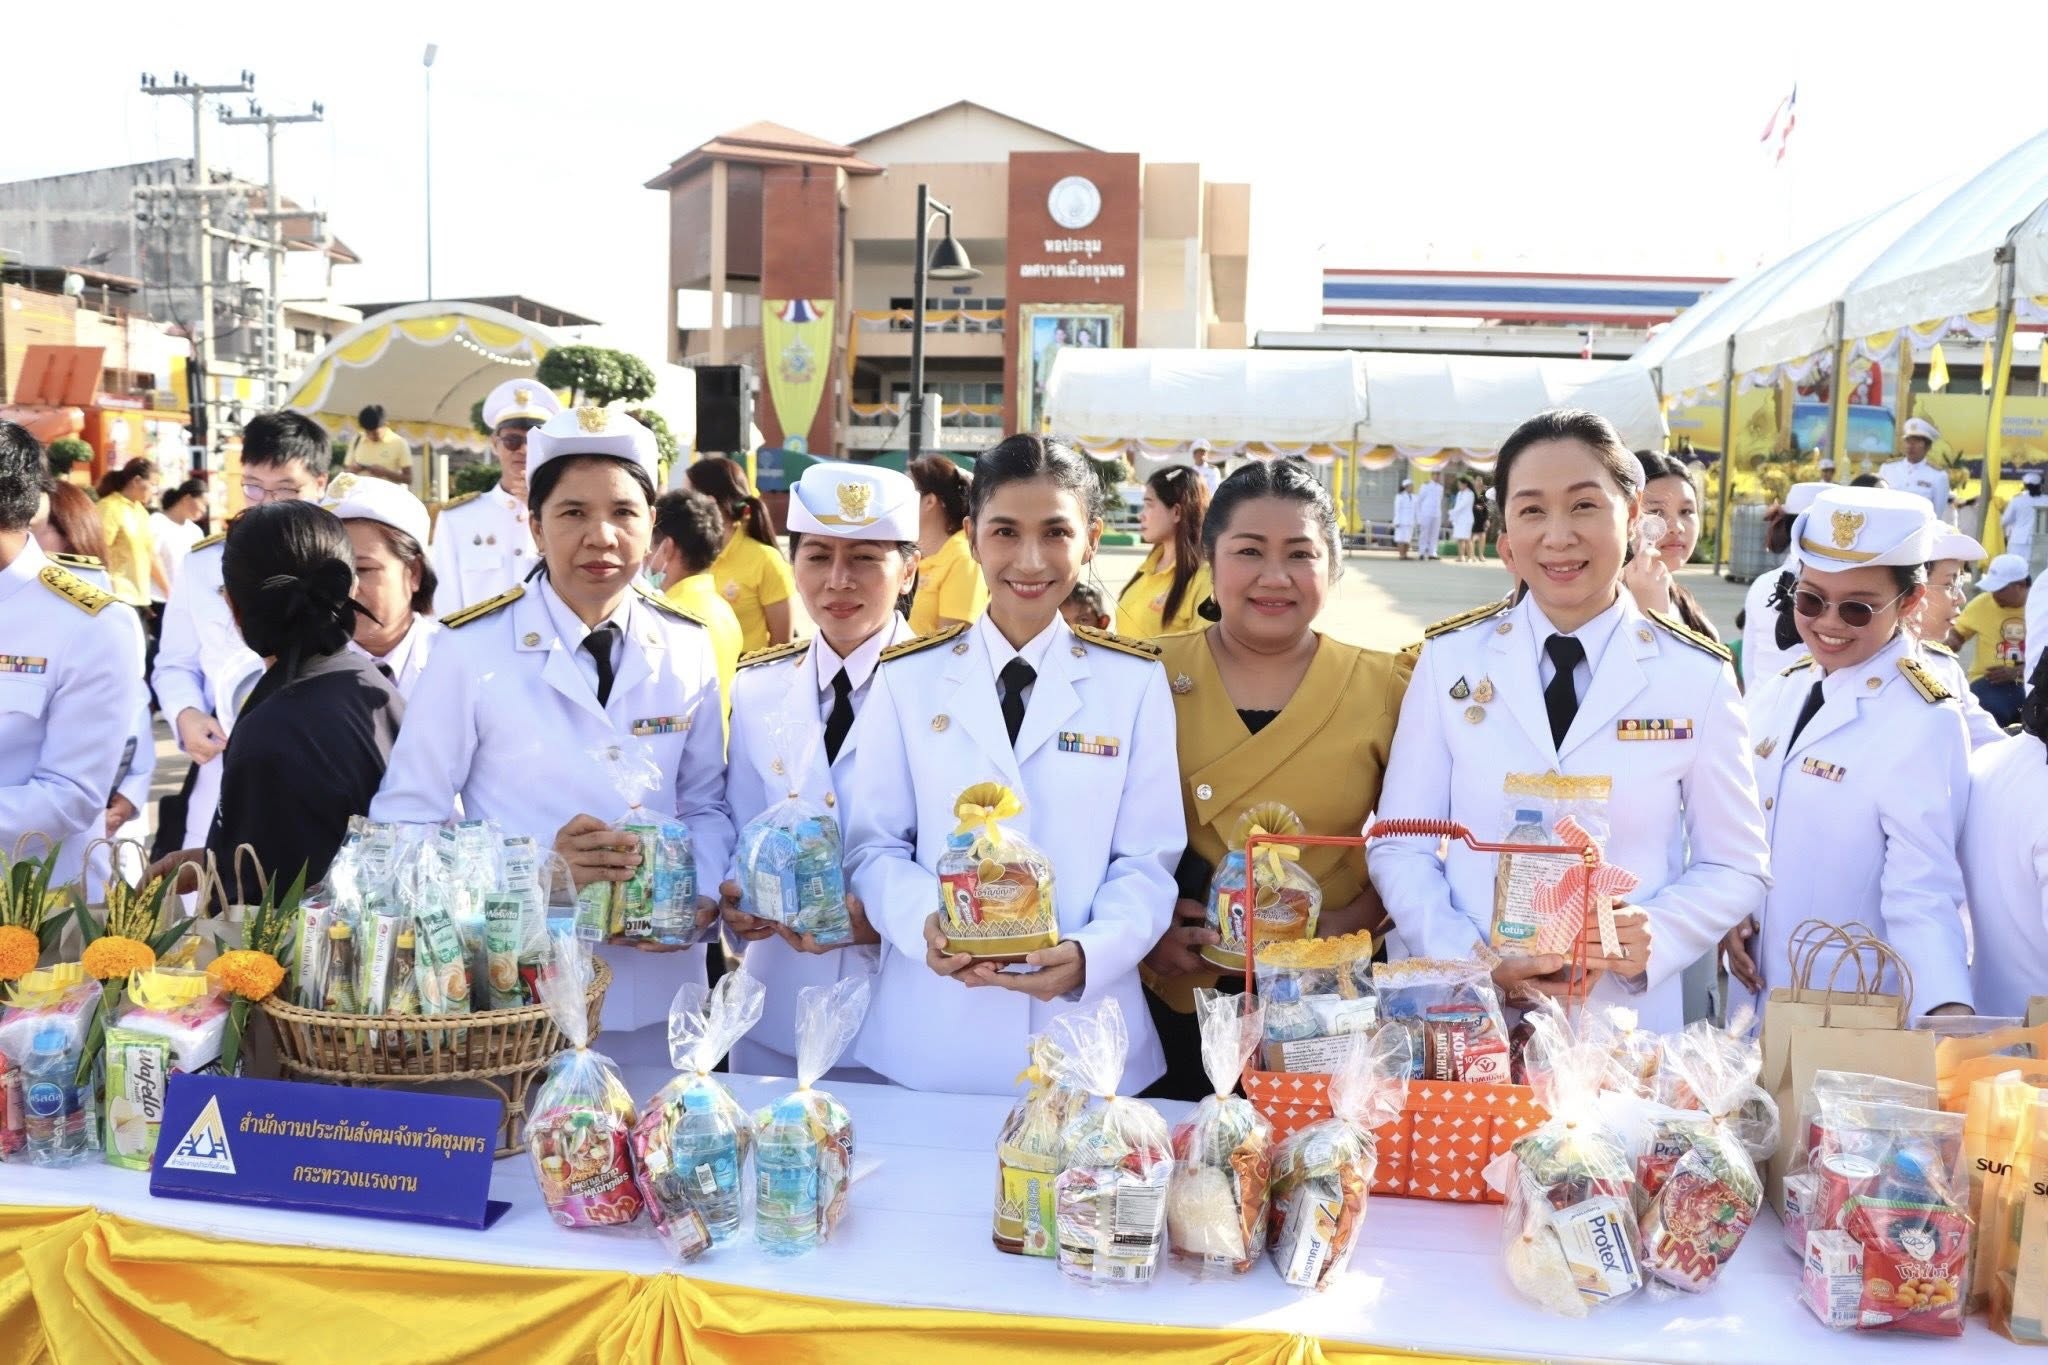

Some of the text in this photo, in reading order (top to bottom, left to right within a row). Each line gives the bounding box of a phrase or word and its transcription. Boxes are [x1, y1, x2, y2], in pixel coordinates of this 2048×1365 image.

[1044, 238, 1101, 258] หอประชุม
[625, 920, 651, 930] MILO
[1436, 1032, 1447, 1080] MACCHIAT
[135, 1049, 161, 1118] Wafello
[239, 1111, 486, 1158] สำนักงานประกันสังคมจังหวัดชุมพร
[1653, 1142, 1682, 1156] Pro
[293, 1164, 417, 1192] กระทรวงแรงงาน
[1298, 1236, 1321, 1283] โพรเทคส์
[1588, 1214, 1622, 1273] Protex
